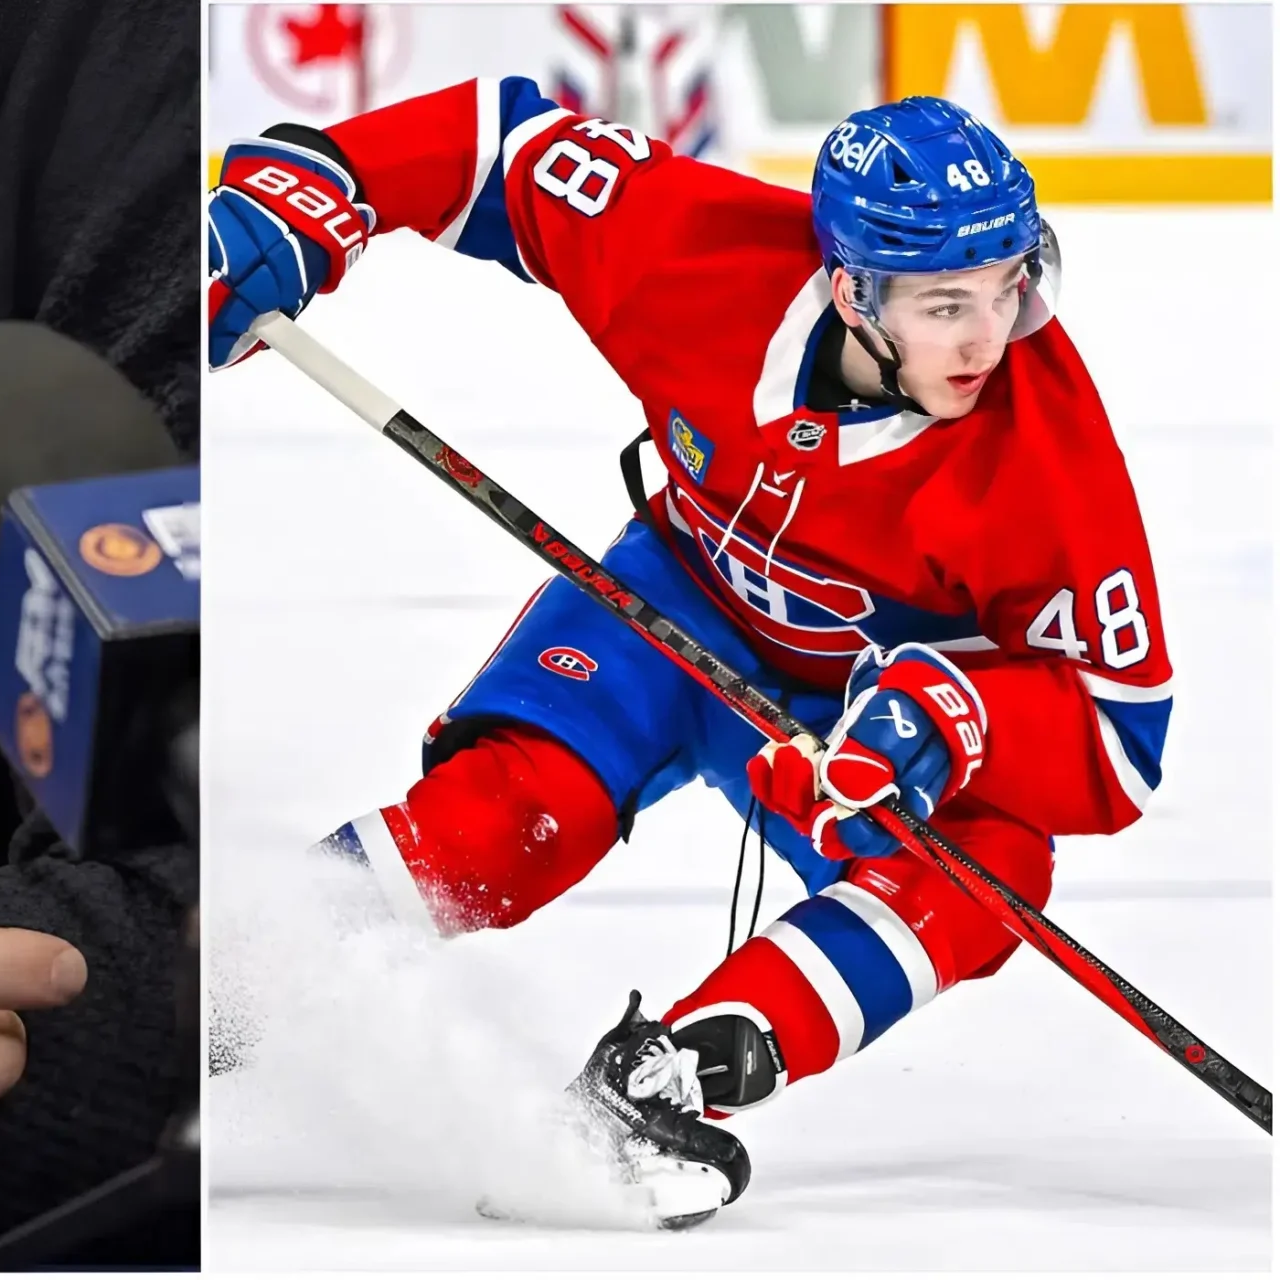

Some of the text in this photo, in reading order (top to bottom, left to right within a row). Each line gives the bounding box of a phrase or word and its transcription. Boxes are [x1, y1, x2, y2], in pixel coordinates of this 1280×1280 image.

[532, 117, 653, 218] 48
[830, 121, 888, 177] Bell
[946, 159, 991, 192] 48
[1025, 567, 1151, 671] 48
